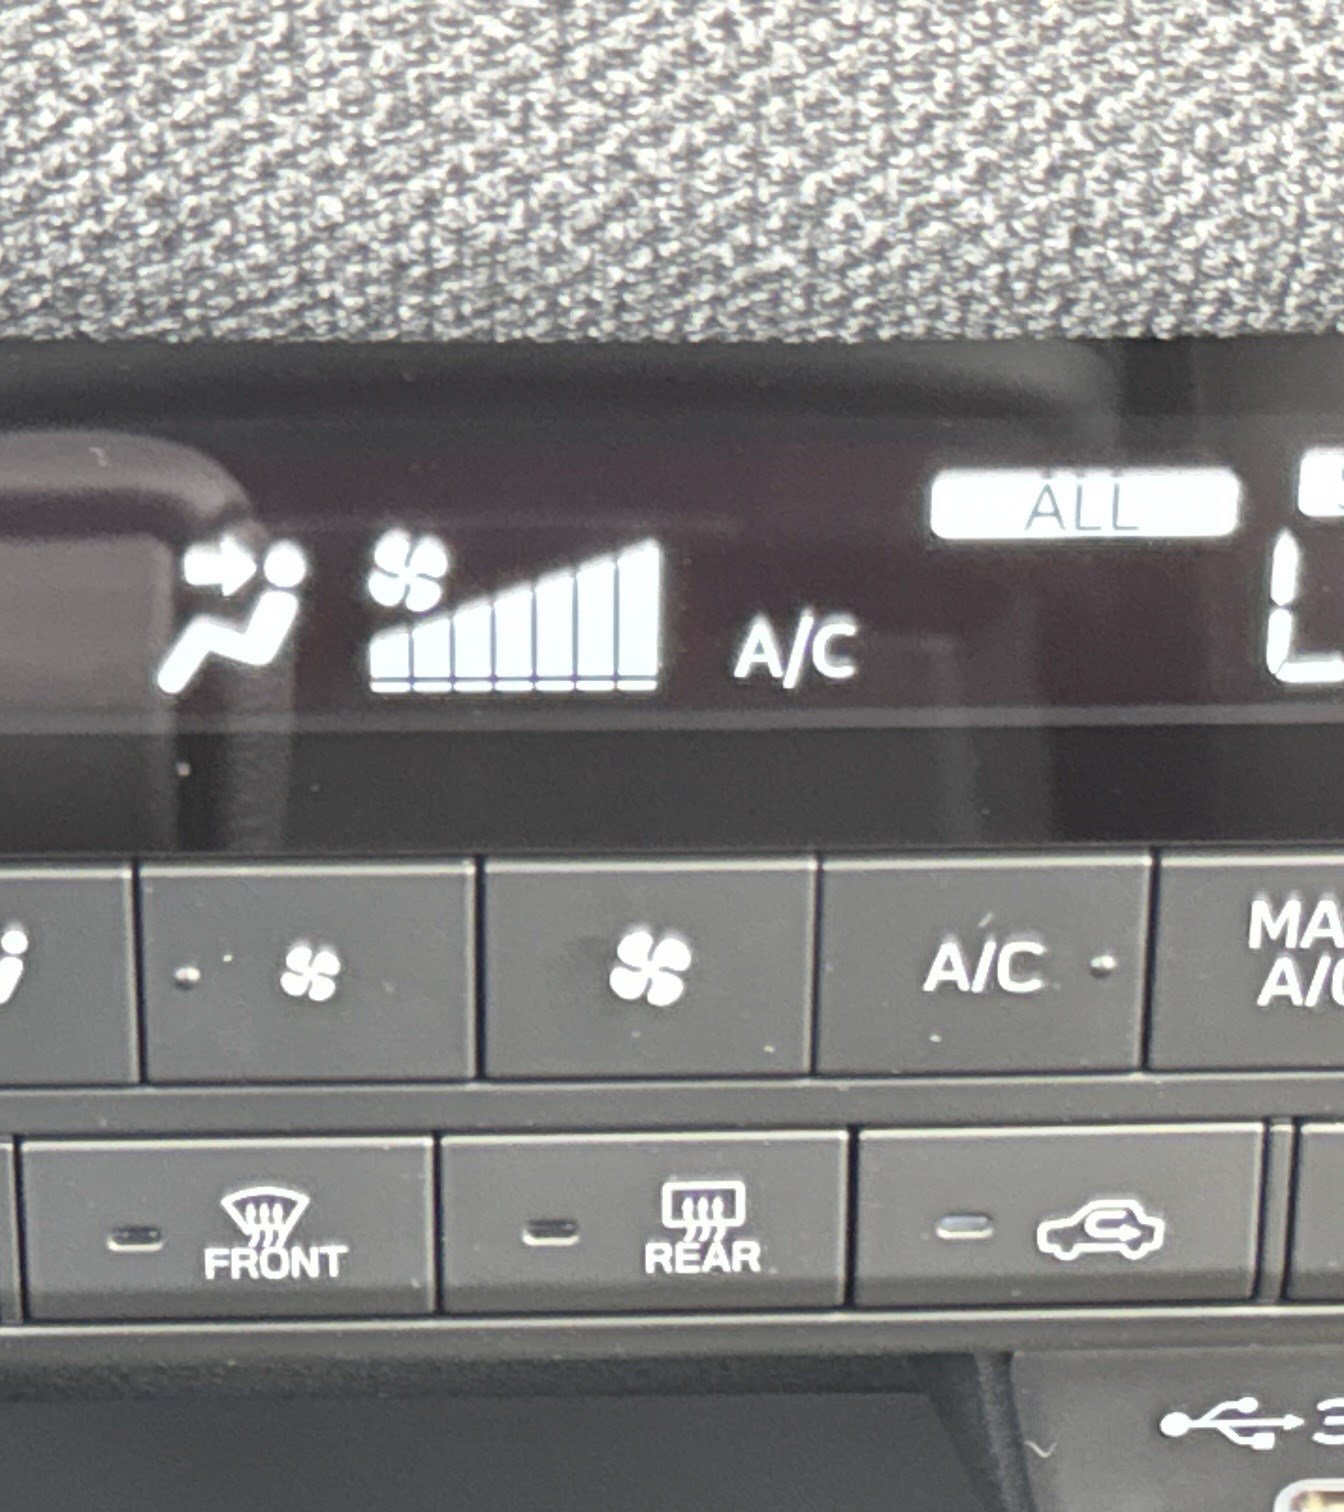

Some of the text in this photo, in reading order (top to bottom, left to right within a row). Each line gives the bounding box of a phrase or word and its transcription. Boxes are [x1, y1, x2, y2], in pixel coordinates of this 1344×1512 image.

[1024, 480, 1140, 534] ALL
[732, 609, 860, 689] A/C
[922, 934, 1048, 995] A/C
[203, 1244, 348, 1281] FRONT
[642, 1239, 763, 1275] REAR
